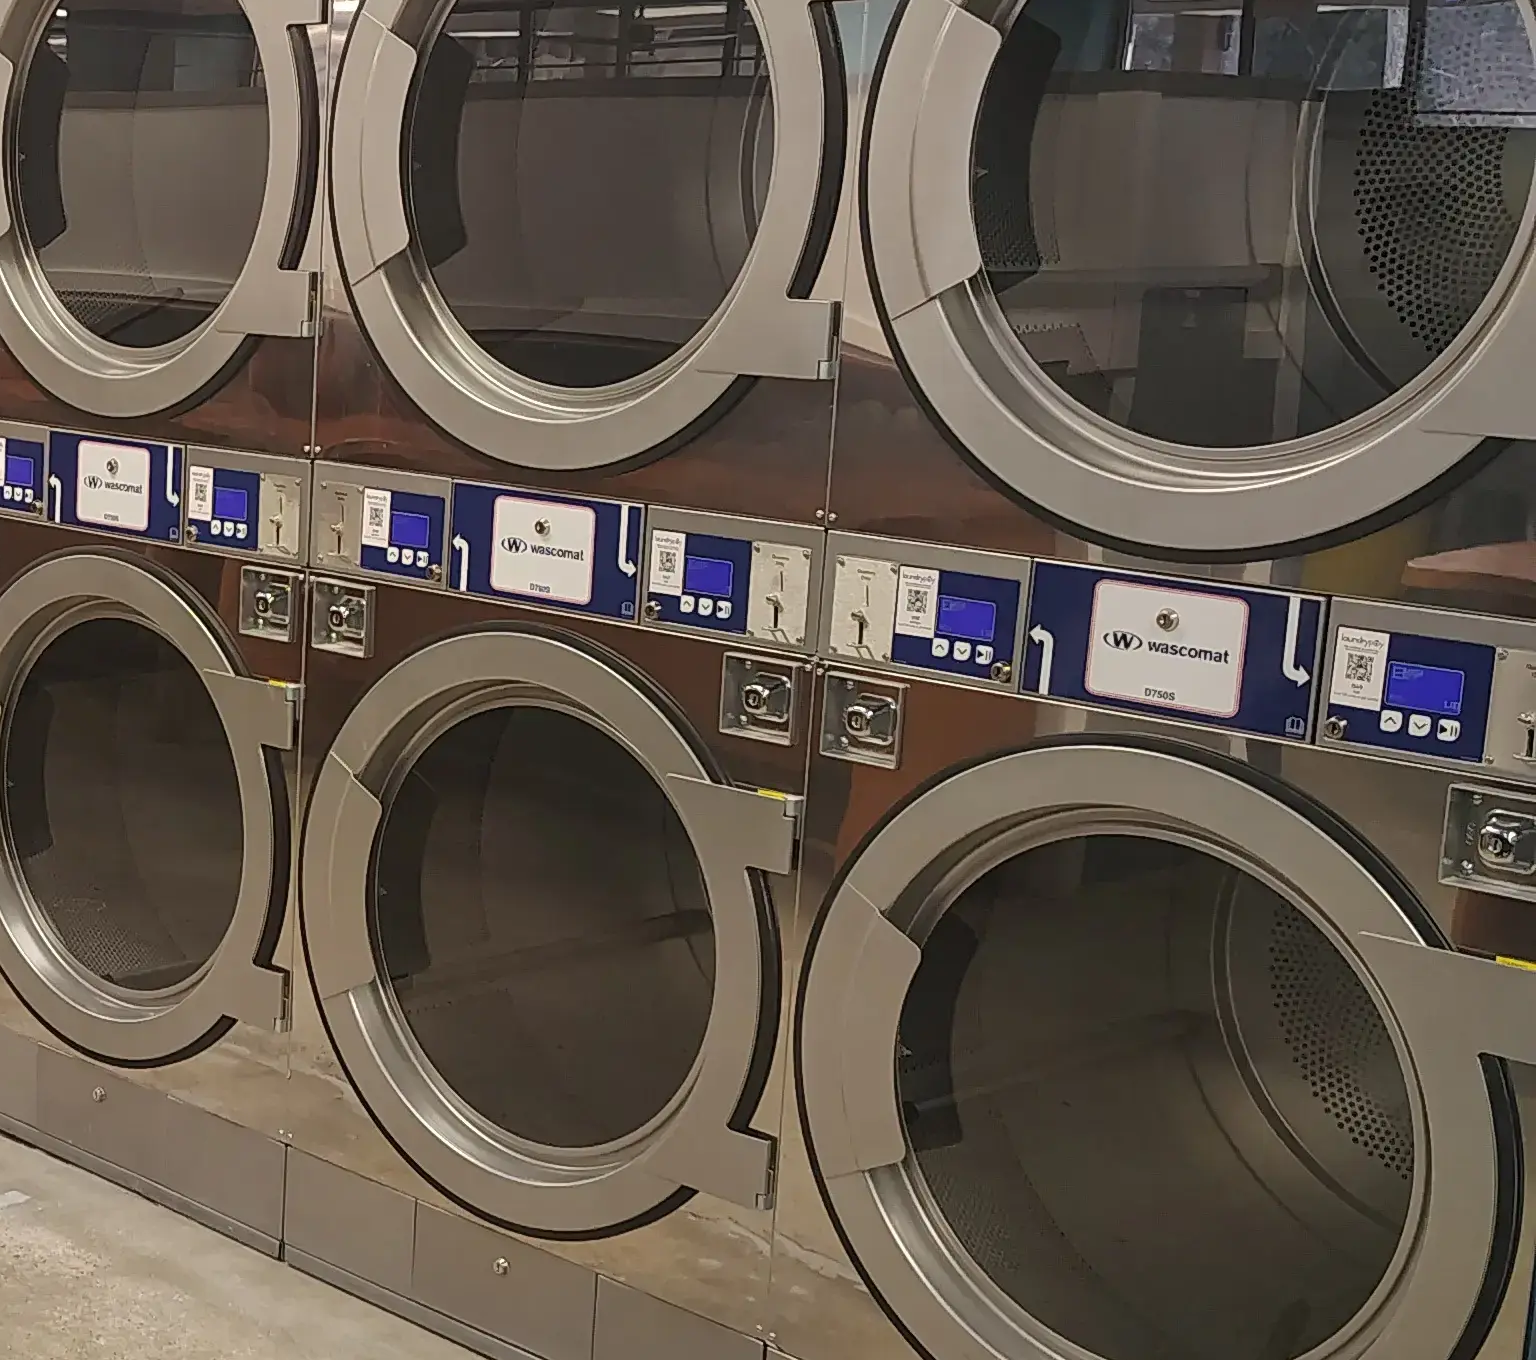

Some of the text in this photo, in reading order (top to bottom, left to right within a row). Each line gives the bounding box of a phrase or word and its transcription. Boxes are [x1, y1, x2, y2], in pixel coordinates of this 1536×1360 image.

[105, 481, 143, 494] wascomat
[530, 543, 584, 561] wascomat
[1147, 640, 1230, 664] wascomat
[1144, 687, 1176, 701] D750S
